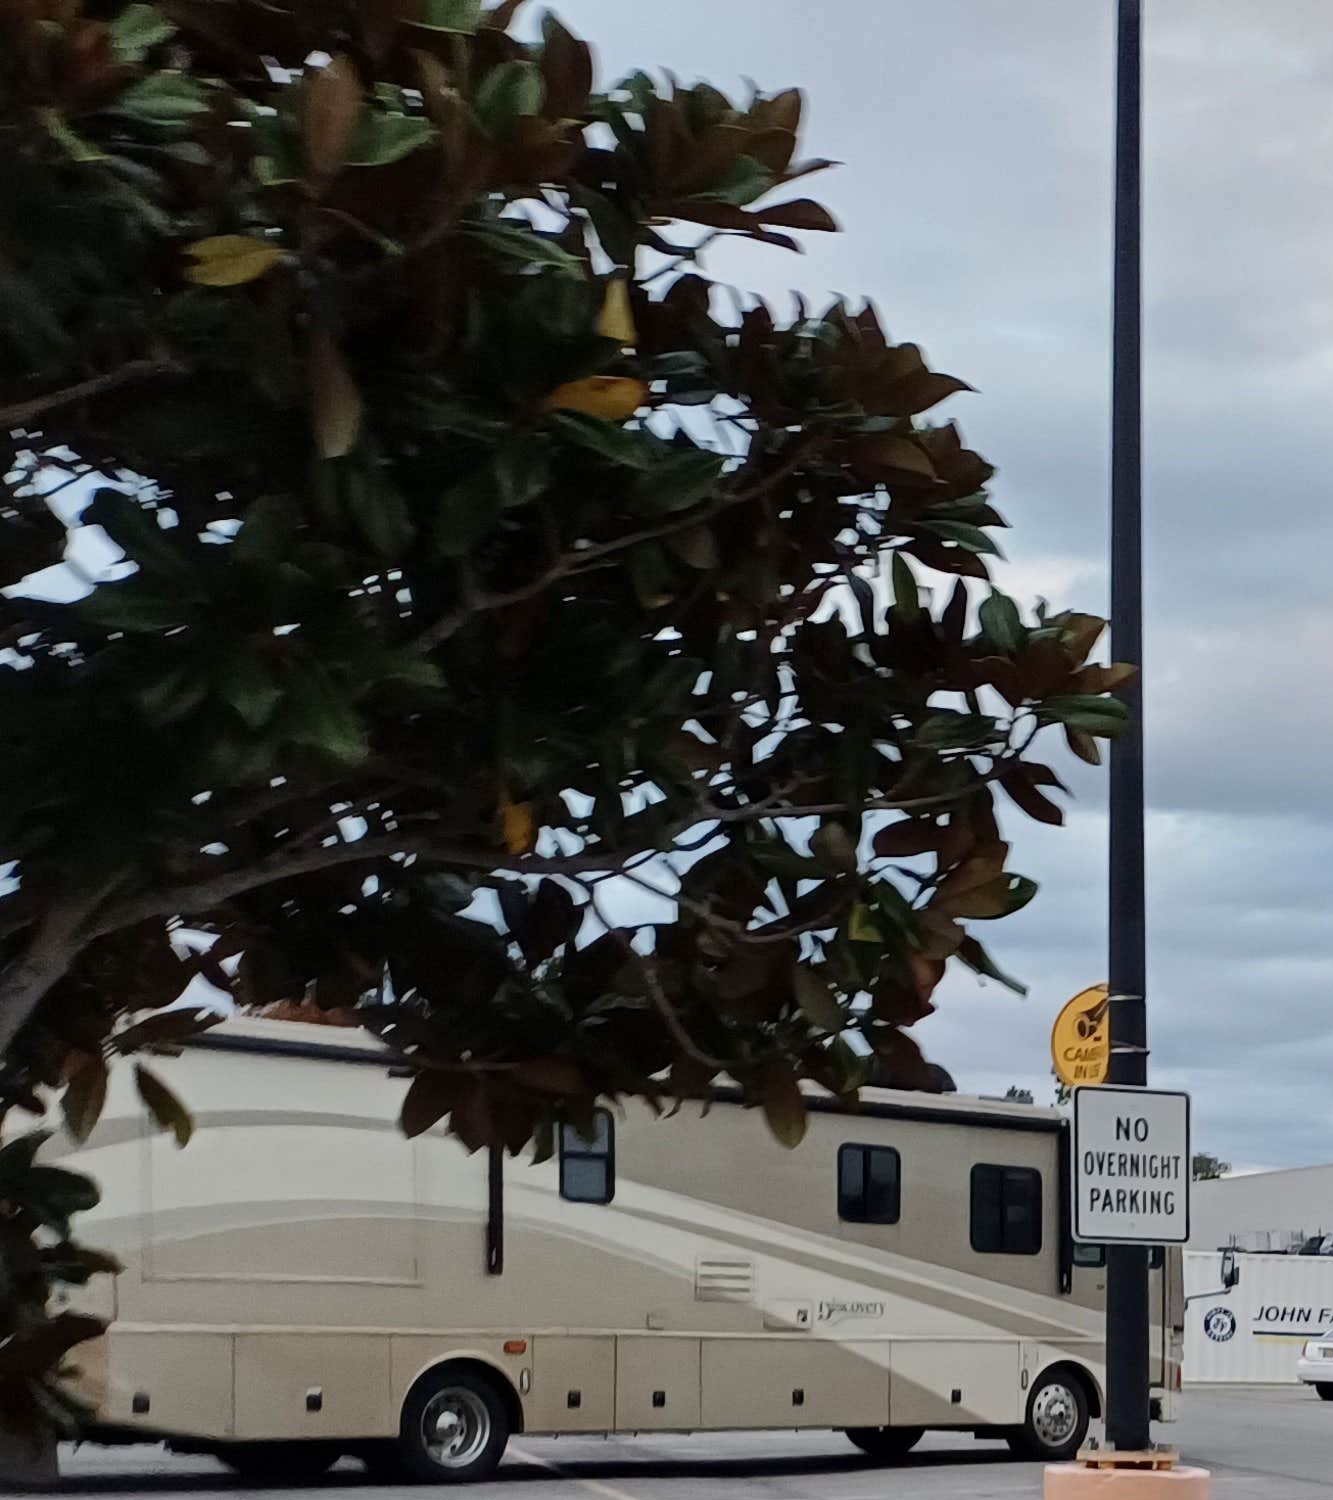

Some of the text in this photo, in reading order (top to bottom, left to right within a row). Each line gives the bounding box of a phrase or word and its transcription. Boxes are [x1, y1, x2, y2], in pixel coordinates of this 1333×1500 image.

[1116, 1116, 1149, 1142] NO
[1084, 1150, 1181, 1179] OVERNIGHT
[1090, 1187, 1175, 1215] PARKING
[1253, 1305, 1312, 1322] JOHN
